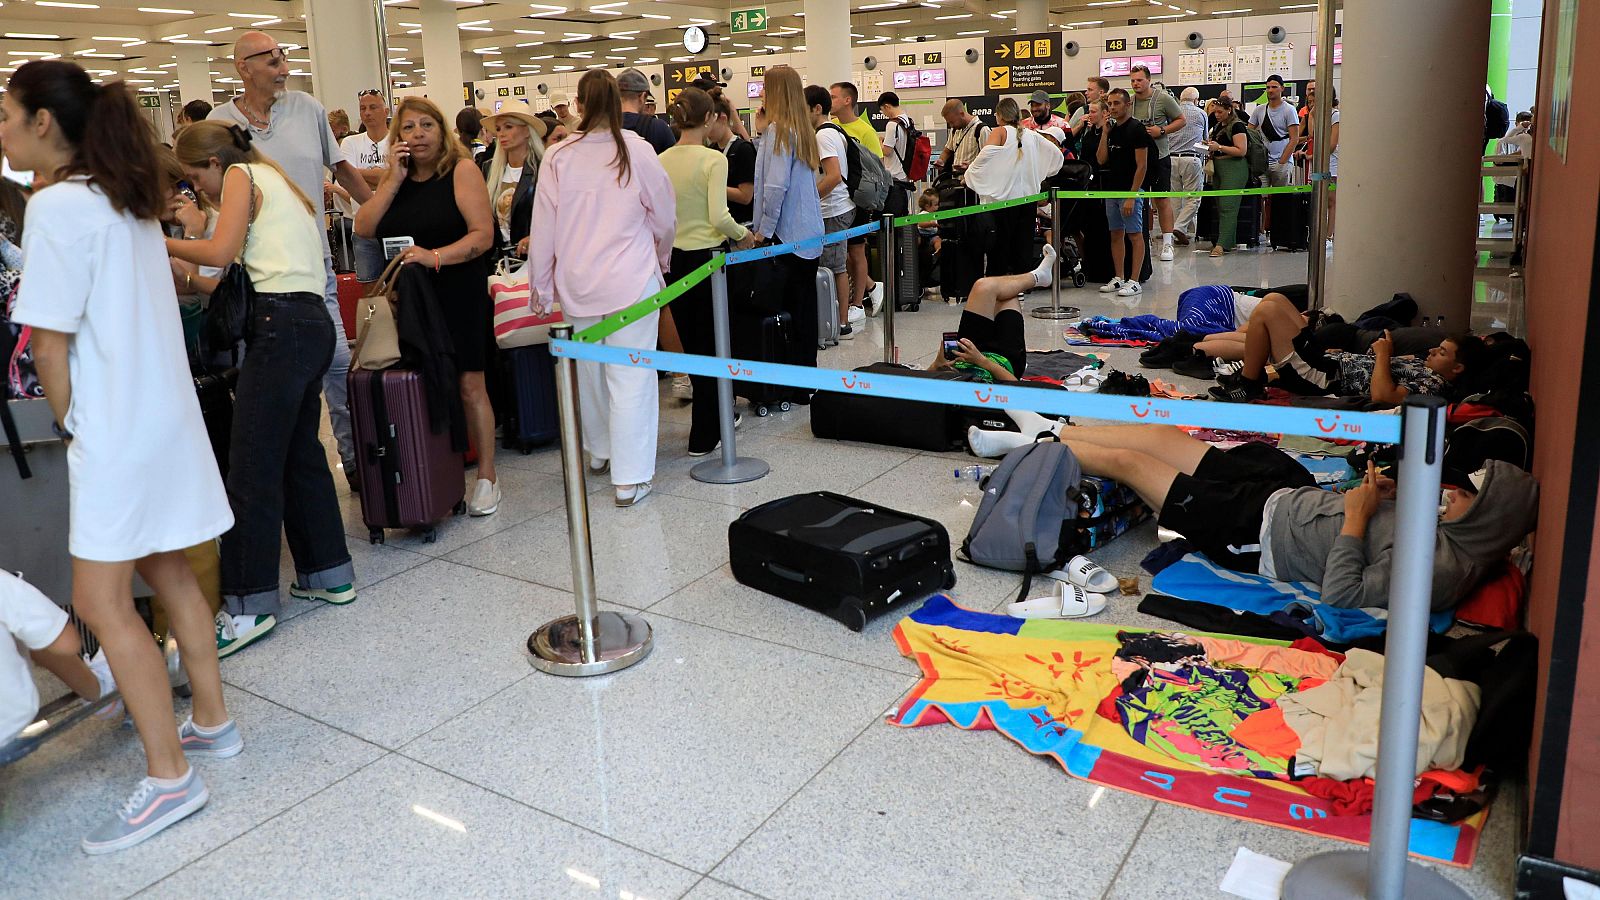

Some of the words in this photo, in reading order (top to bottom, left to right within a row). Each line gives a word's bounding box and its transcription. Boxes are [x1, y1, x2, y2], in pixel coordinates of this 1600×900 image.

[1110, 41, 1122, 50] 48
[1141, 39, 1154, 48] 49
[902, 56, 912, 64] 46
[928, 54, 938, 62] 47
[1154, 409, 1170, 418] TUI
[1343, 424, 1362, 432] TUI
[1074, 586, 1084, 602] PUM
